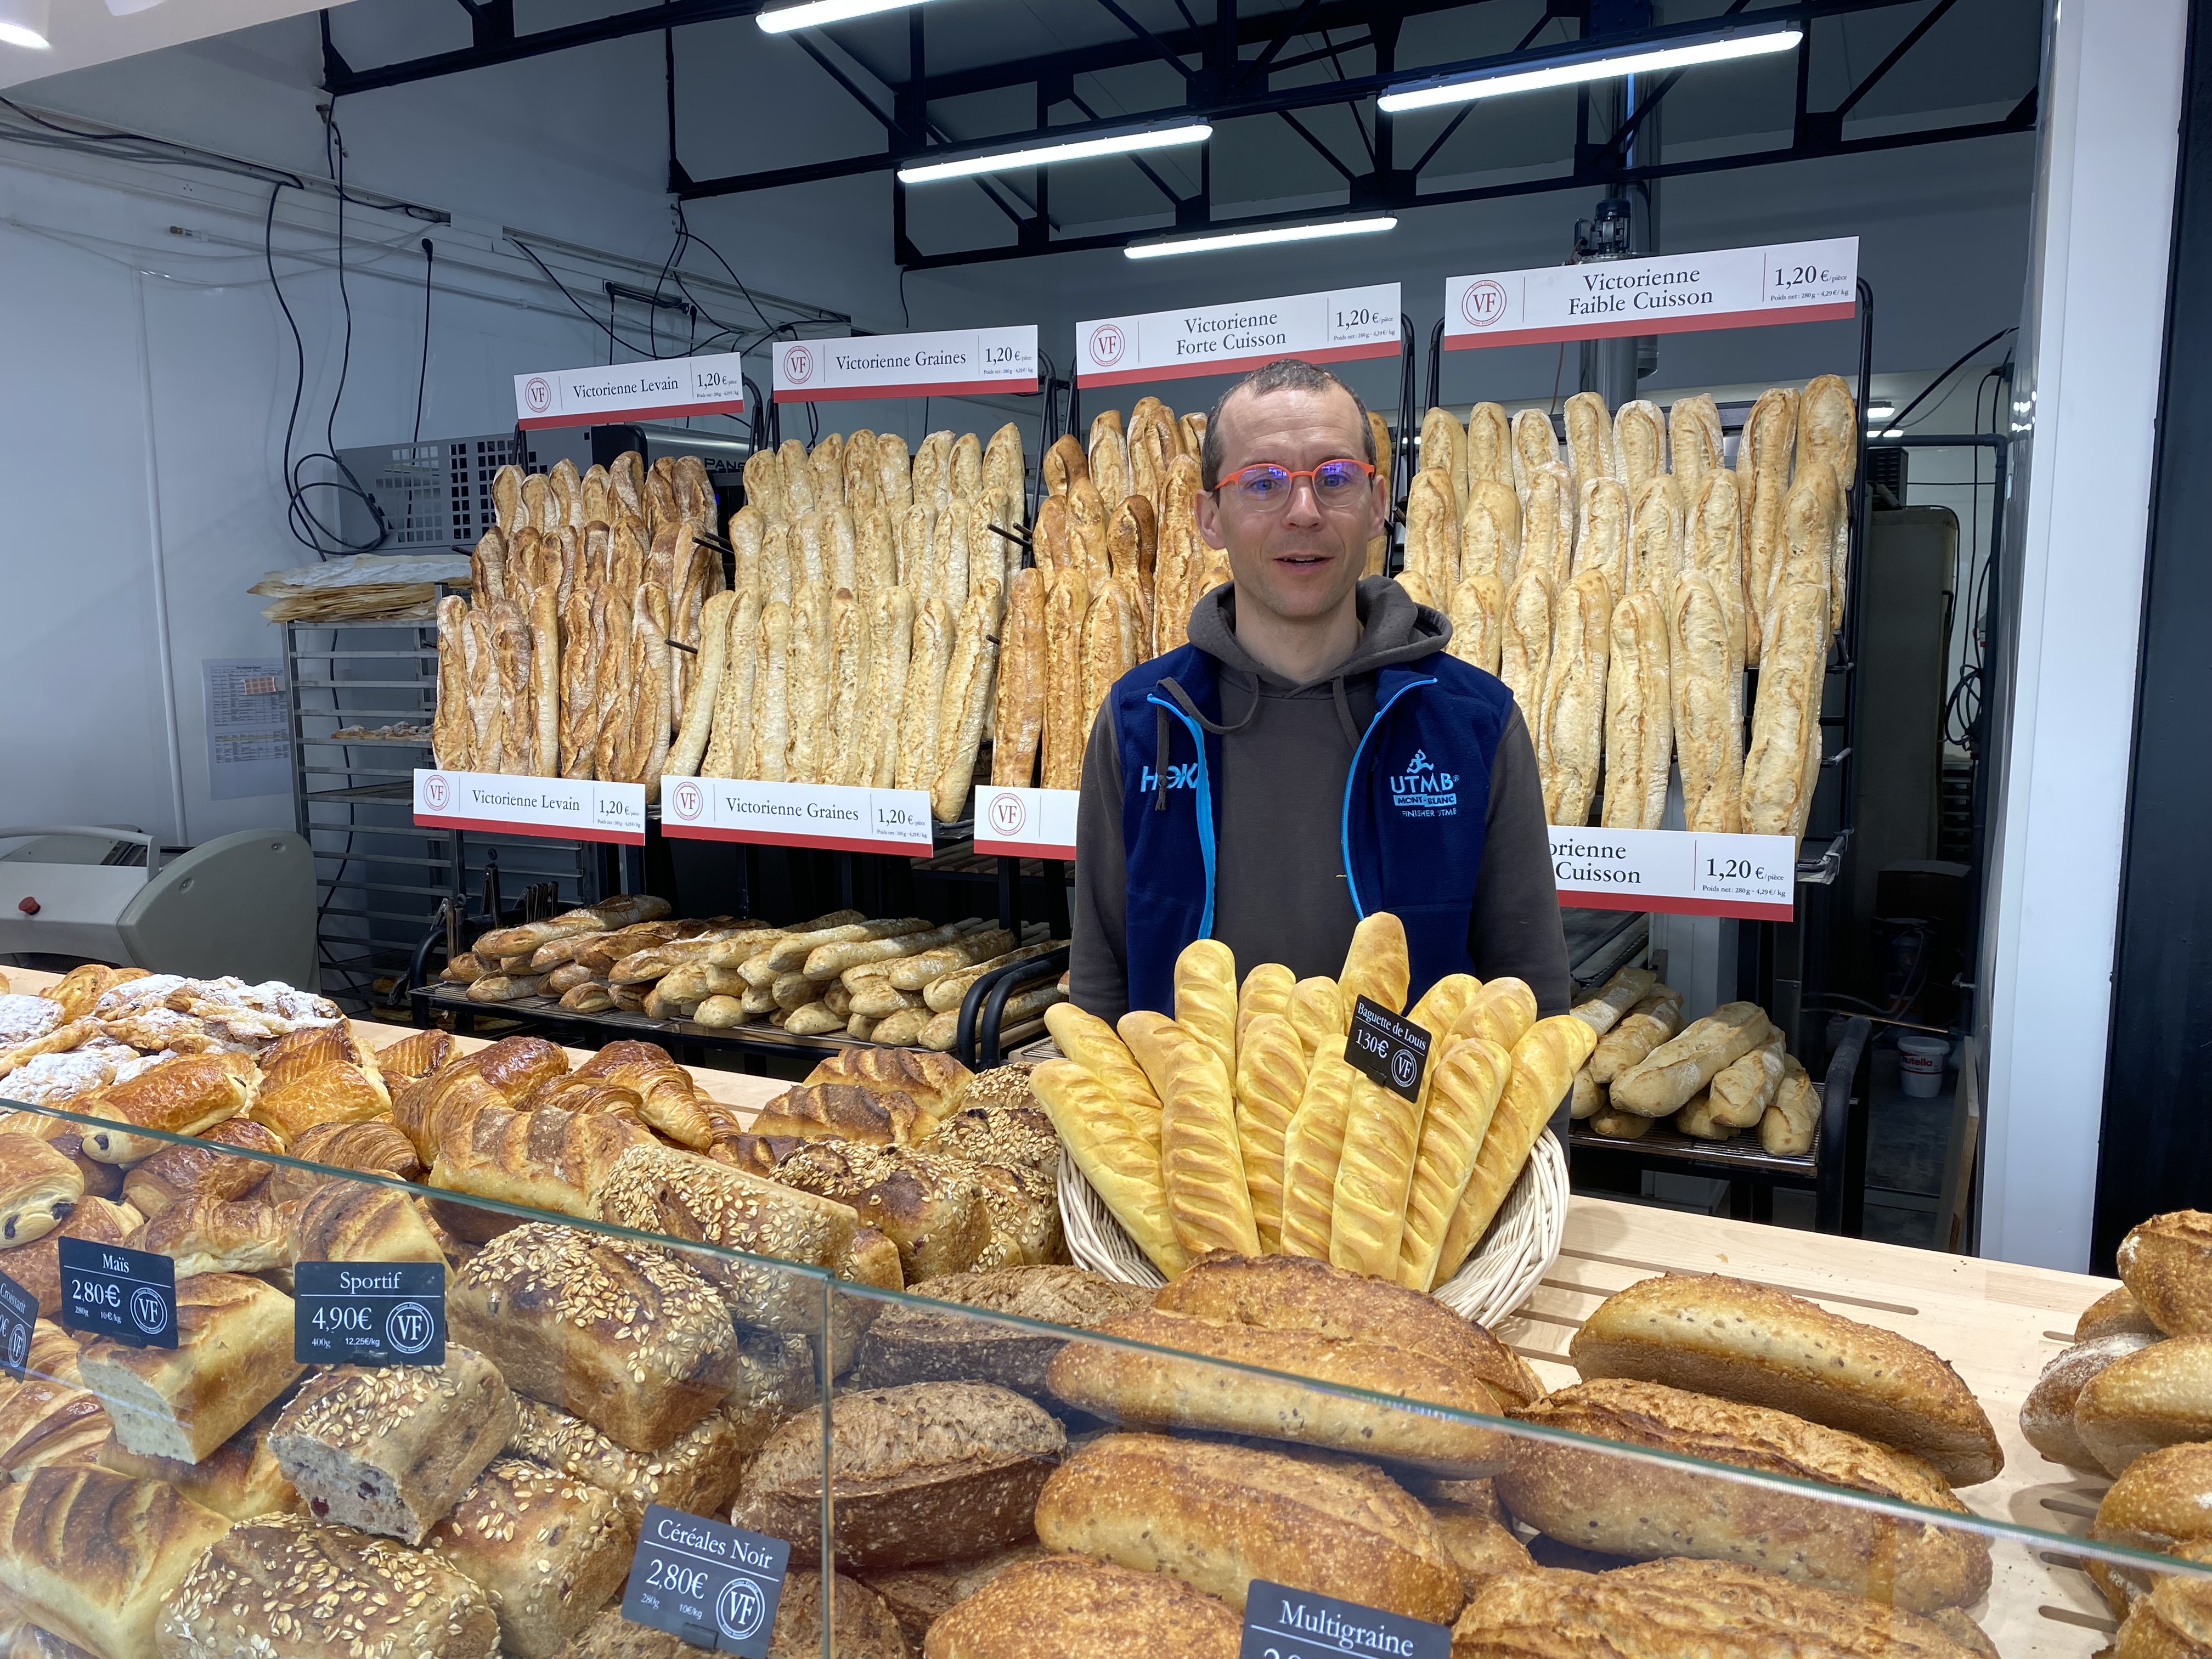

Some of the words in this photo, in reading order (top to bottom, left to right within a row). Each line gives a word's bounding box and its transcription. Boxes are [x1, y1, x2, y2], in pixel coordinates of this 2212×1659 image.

[1584, 269, 1701, 292] Victorienne
[1775, 266, 1817, 289] 1,20
[1472, 292, 1496, 314] VF
[1568, 290, 1626, 315] Faible
[1633, 289, 1713, 310] Cuisson
[1184, 313, 1277, 334] Victorienne
[1336, 309, 1369, 330] 1,20
[1098, 336, 1116, 354] VF
[1176, 340, 1217, 356] Forte
[1223, 332, 1286, 351] Cuisson
[791, 357, 806, 373] VF
[836, 354, 910, 370] Victorienne
[915, 351, 966, 366] Graines
[986, 347, 1012, 365] 1,20
[573, 381, 637, 398] Victorienne
[641, 376, 679, 392] Levain
[697, 373, 720, 390] 1,20
[531, 387, 544, 403] VF
[1141, 763, 1198, 792] HOK
[430, 785, 443, 800] VF
[472, 789, 537, 808] Victorienne
[541, 794, 580, 811] Levain
[680, 793, 696, 809] VF
[600, 800, 623, 816] 1,20
[726, 797, 802, 816] Victorienne
[807, 803, 859, 821] Graines
[878, 809, 905, 826] 1,20
[998, 805, 1017, 823] VF
[1402, 809, 1435, 817] FINISHER
[1555, 861, 1641, 883] Cuisson
[1707, 858, 1751, 881] 1,20
[1357, 1002, 1391, 1030] Baguette
[1392, 1023, 1403, 1037] de
[1404, 1029, 1426, 1051] Louis
[1399, 1056, 1412, 1079] VF
[103, 1254, 129, 1273] Maïs
[72, 1279, 121, 1307] 2,80€
[340, 1272, 402, 1295] Sportif
[75, 1306, 89, 1317] 280g
[138, 1298, 158, 1323] VF
[312, 1307, 372, 1331] 4,90€
[397, 1315, 422, 1340] VF
[13, 1333, 22, 1357] VF
[312, 1338, 331, 1349] 400g
[658, 1519, 726, 1555] Céréales
[730, 1539, 772, 1569] Noir
[646, 1559, 708, 1600] 2,80€
[641, 1593, 660, 1609] 280g
[730, 1591, 755, 1625] VF
[1278, 1600, 1414, 1657] Multigraine
